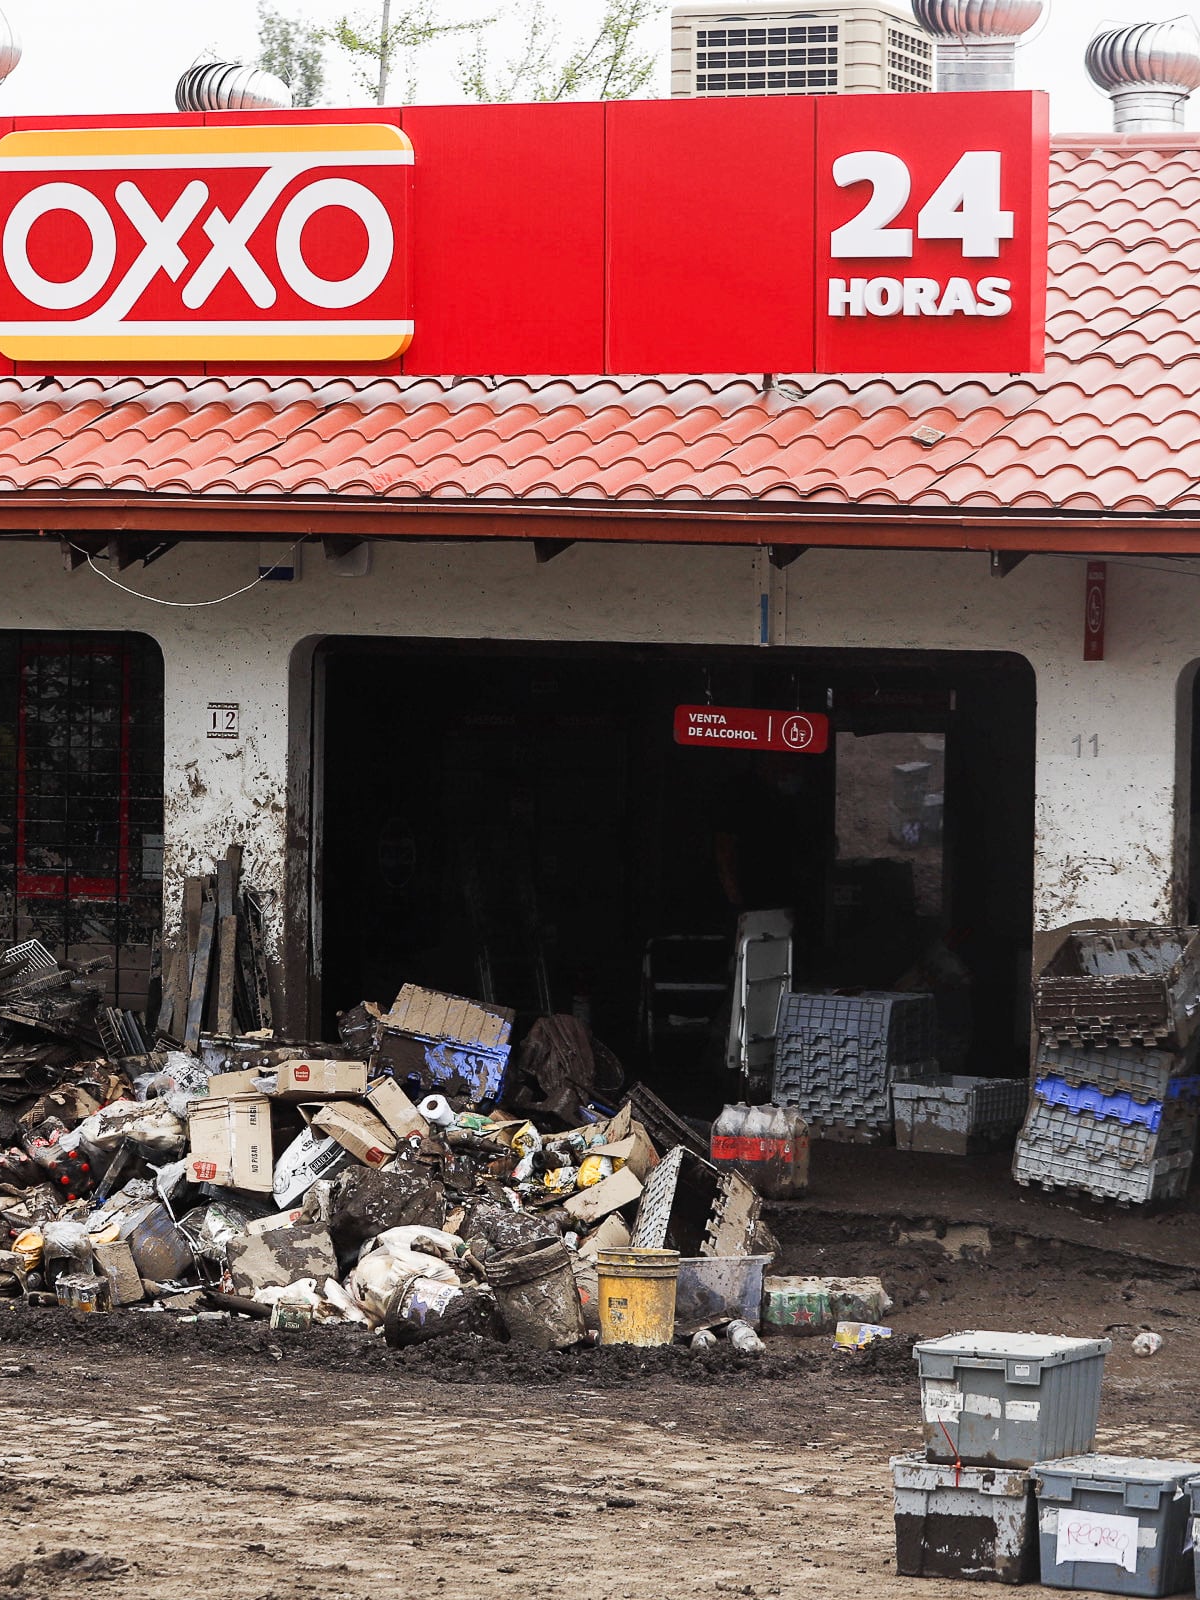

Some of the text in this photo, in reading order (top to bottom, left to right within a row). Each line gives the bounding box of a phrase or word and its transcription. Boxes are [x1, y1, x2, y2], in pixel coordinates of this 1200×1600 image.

[830, 150, 1015, 258] 24
[2, 174, 394, 314] OXXO
[828, 277, 1012, 317] HORAS
[212, 711, 236, 730] 12
[688, 713, 727, 724] VENTA
[688, 727, 758, 741] DE ALCOHOL
[1071, 734, 1099, 758] 11
